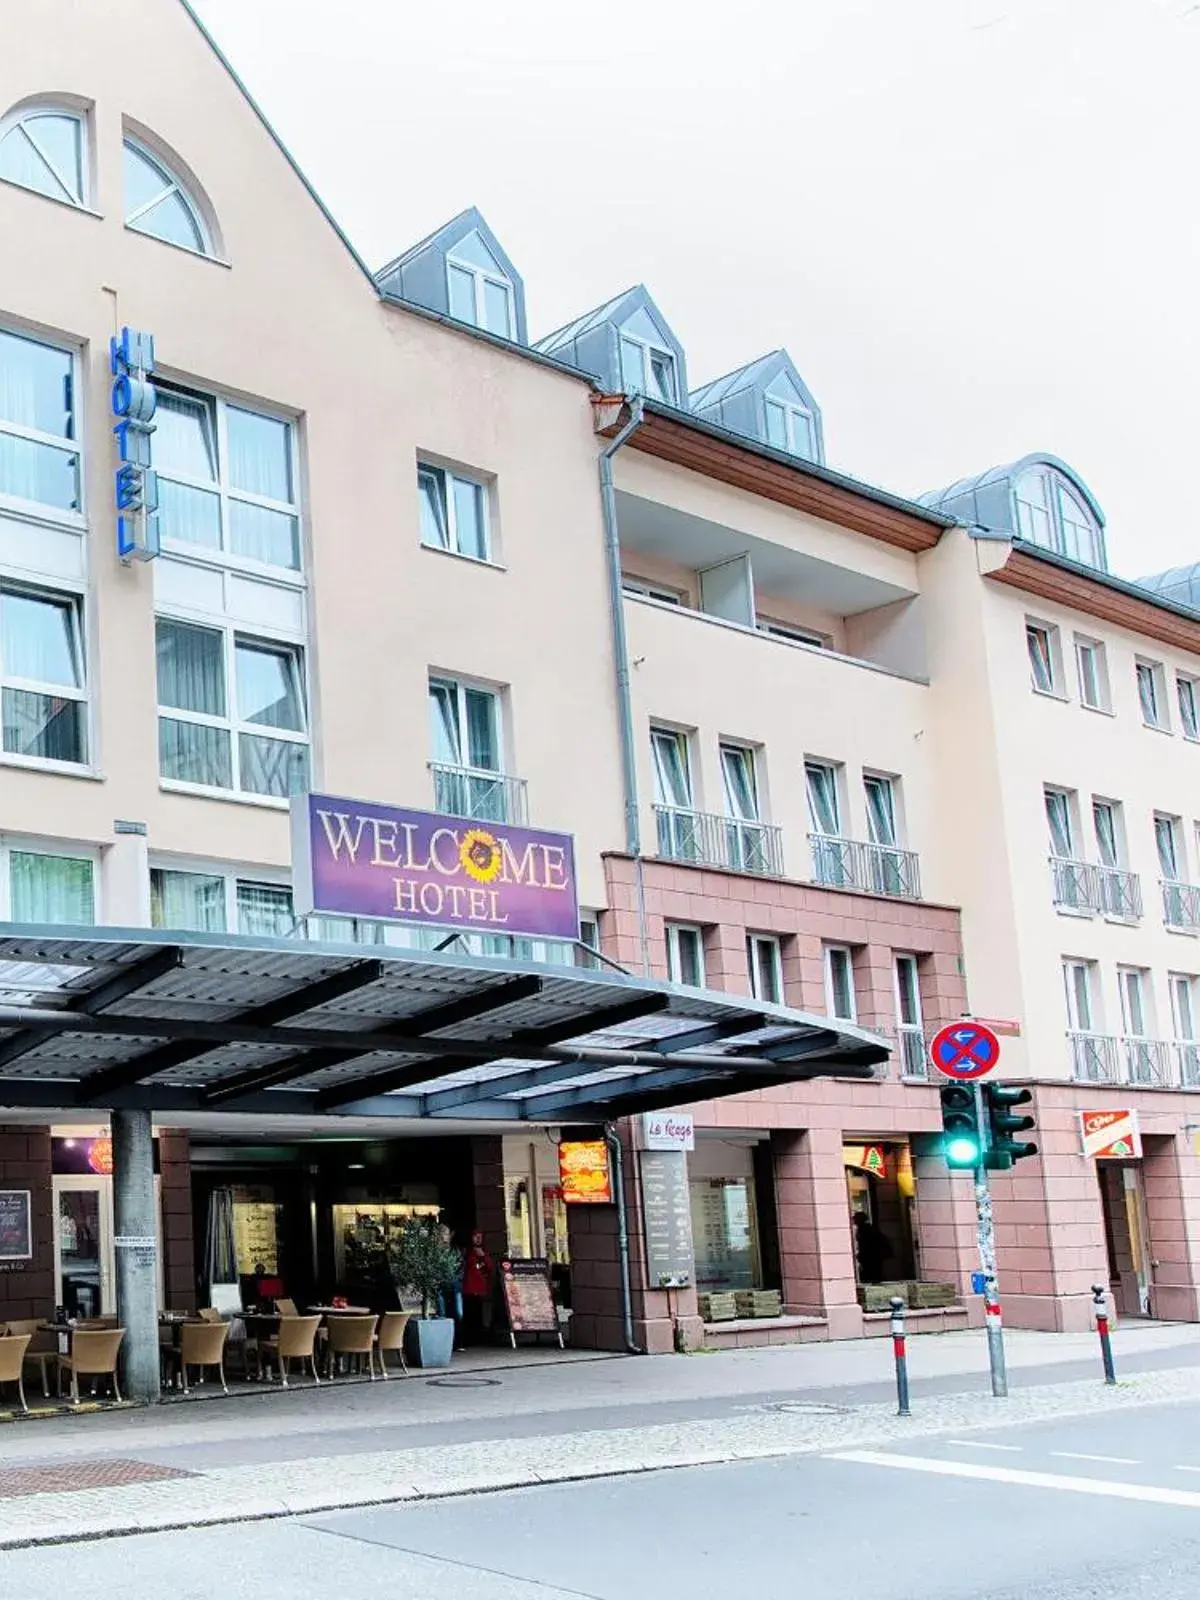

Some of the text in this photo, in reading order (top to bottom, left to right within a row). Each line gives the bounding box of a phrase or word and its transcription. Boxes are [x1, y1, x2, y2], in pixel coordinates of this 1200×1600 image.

[109, 326, 137, 557] HOTEL
[316, 809, 569, 891] WELCOME
[392, 877, 509, 923] HOTEL
